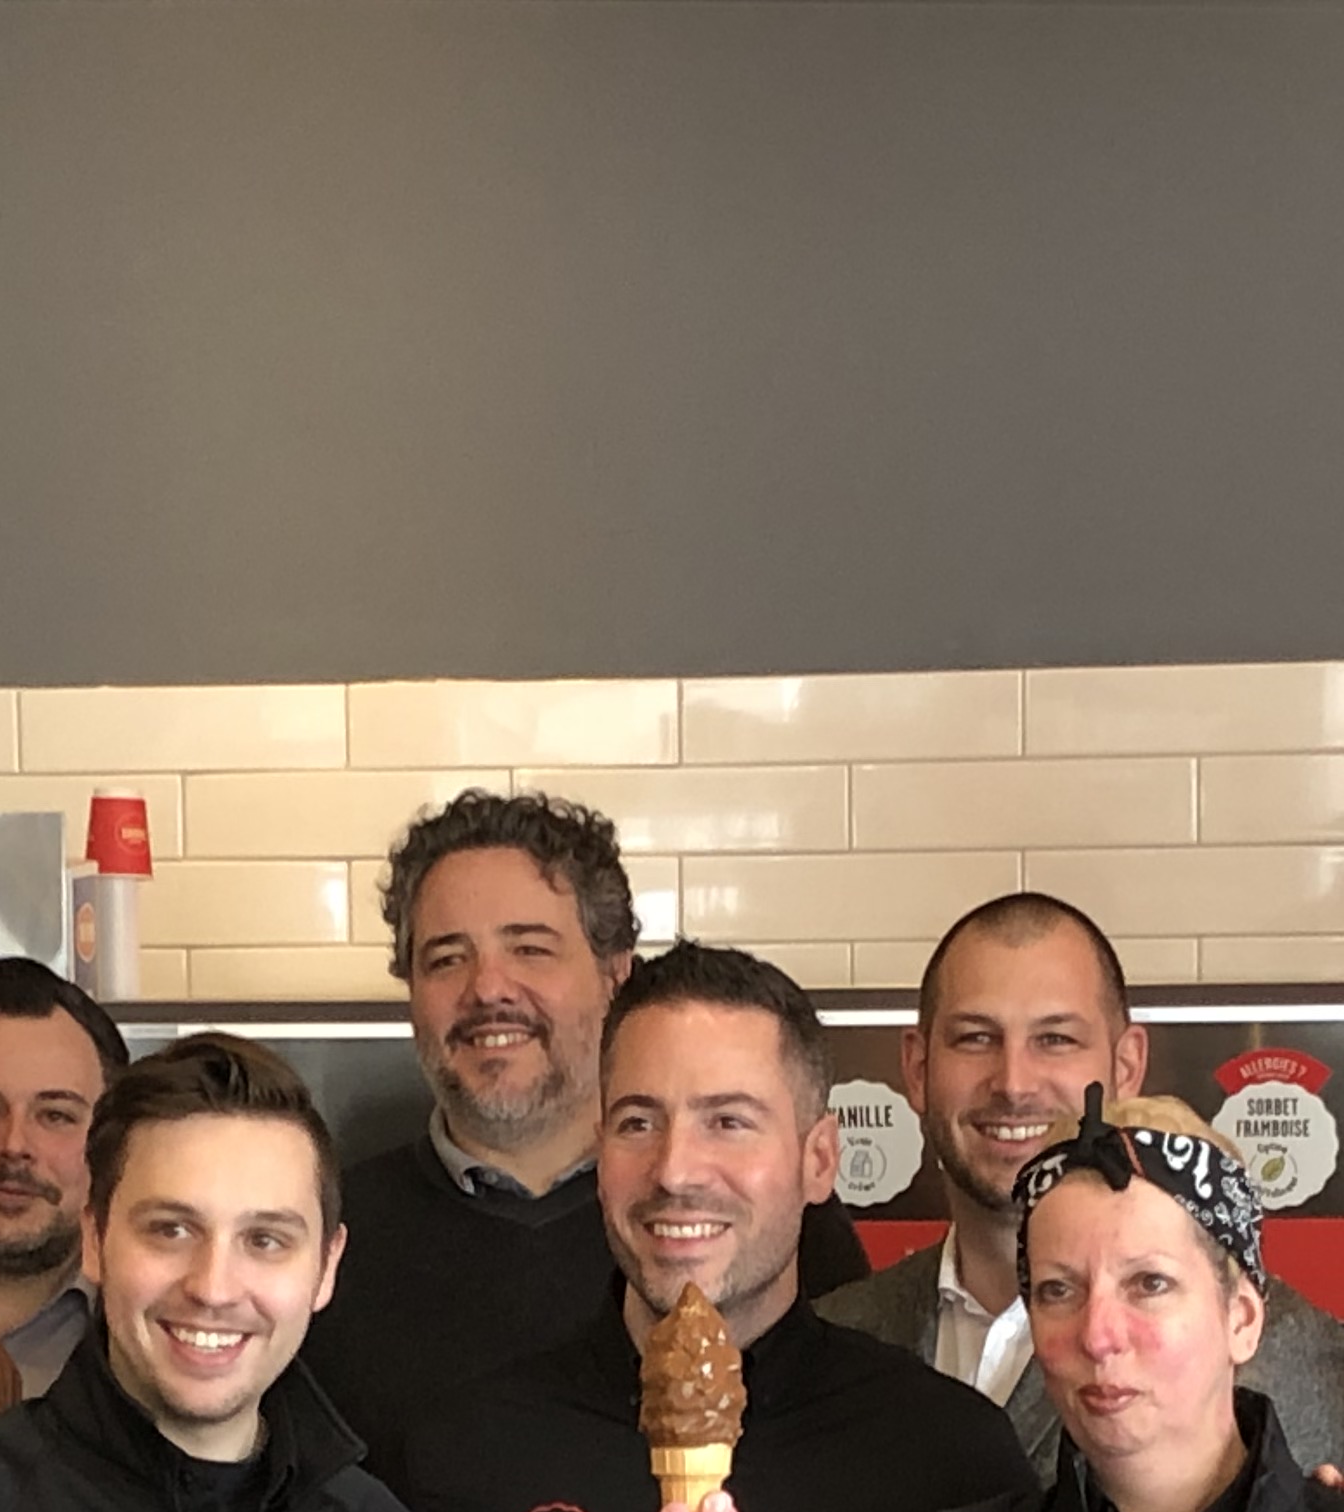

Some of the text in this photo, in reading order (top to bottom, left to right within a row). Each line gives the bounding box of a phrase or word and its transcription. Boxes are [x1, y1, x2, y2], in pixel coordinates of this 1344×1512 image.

[828, 1105, 895, 1128] ANILLE
[1247, 1098, 1299, 1116] SORBET
[1236, 1119, 1311, 1138] FRAMBOISE
